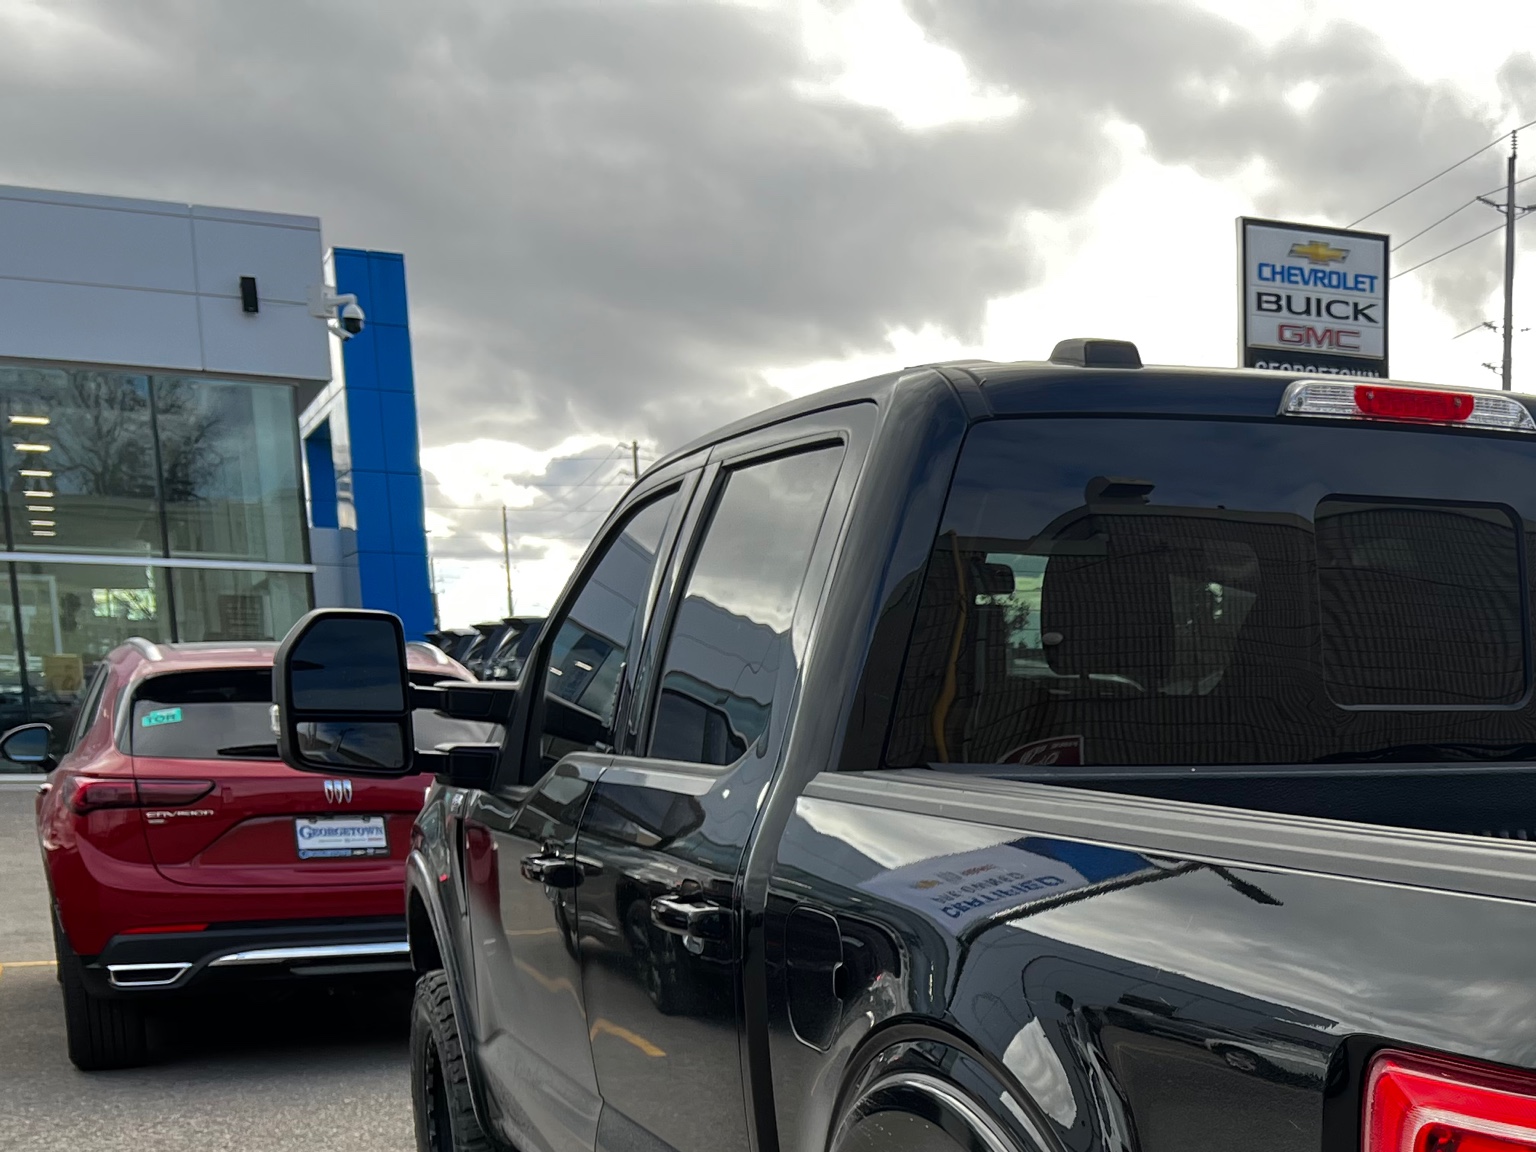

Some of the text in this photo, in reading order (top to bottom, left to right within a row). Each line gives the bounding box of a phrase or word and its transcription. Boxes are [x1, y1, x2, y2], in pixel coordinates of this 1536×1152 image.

[1257, 262, 1378, 293] CHEVROLET
[1256, 291, 1379, 324] BUICK
[1277, 322, 1362, 352] GMC
